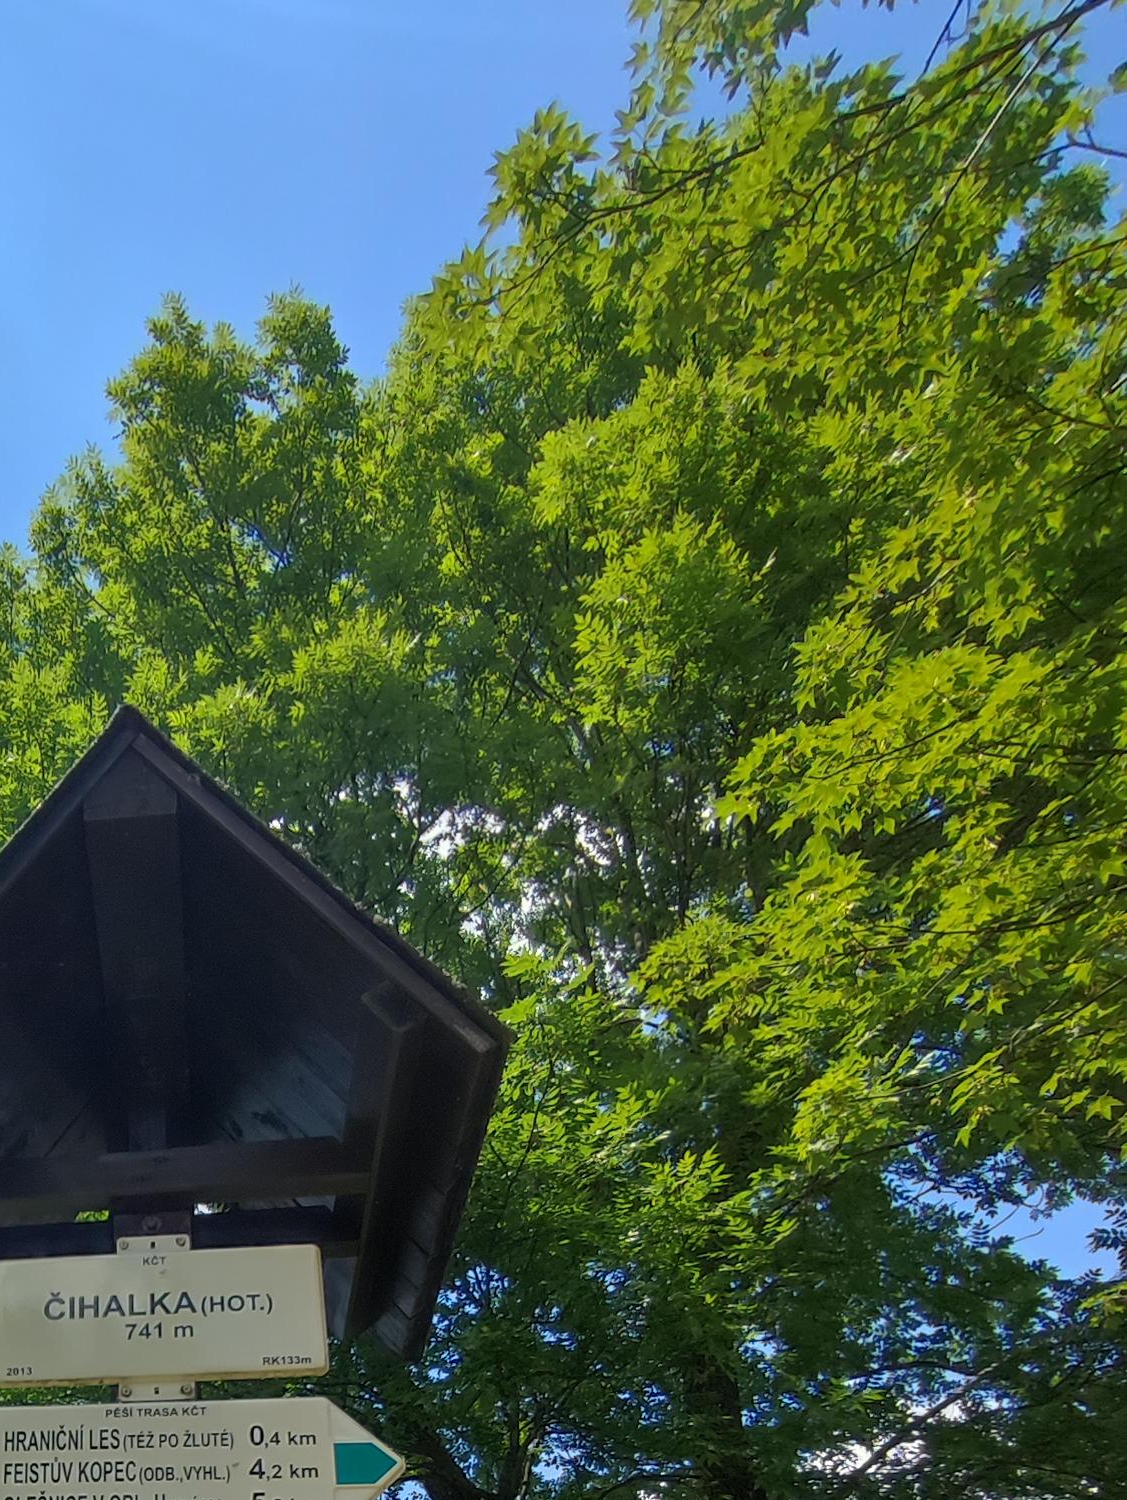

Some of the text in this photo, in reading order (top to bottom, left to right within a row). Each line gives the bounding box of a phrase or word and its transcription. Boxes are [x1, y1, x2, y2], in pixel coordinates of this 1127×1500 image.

[142, 1254, 167, 1266] KČT
[43, 1291, 273, 1321] ČIHALKA (HOT.)
[125, 1321, 194, 1341] 741 m
[262, 1355, 312, 1366] RK133m
[6, 1366, 33, 1377] 2013
[105, 1404, 207, 1419] PĚŠÍ TRASA KČT
[4, 1424, 317, 1452] HRANIČNÍ LES (TÉŽ PO ŽLUTÉ) 0,4 km
[3, 1456, 74, 1485] FEISTŮV
[78, 1460, 137, 1483] KOPEC
[248, 1458, 283, 1481] 4,2
[289, 1463, 319, 1479] km
